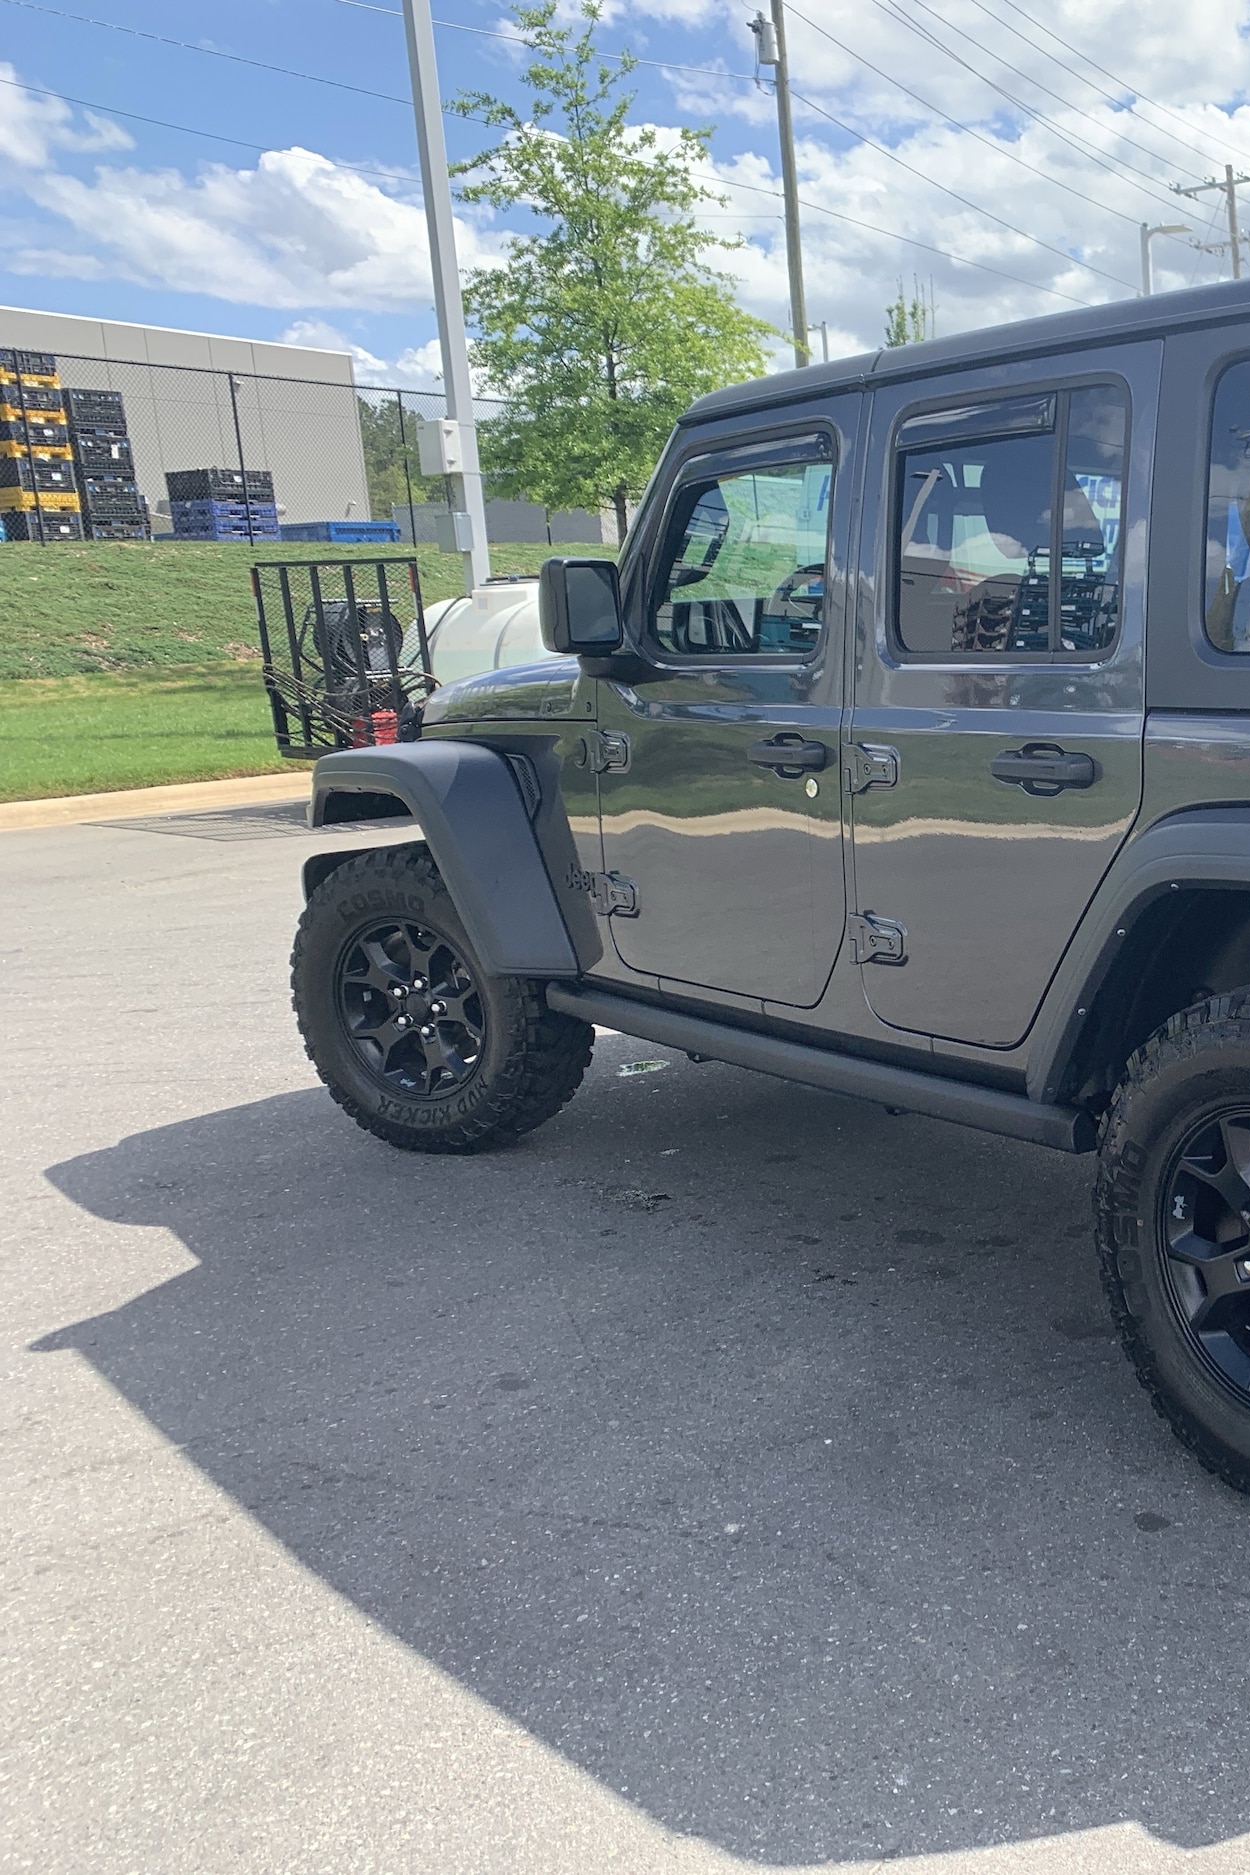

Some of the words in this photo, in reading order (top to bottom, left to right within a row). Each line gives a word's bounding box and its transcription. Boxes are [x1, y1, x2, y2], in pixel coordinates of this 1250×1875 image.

[566, 863, 602, 898] Jeep
[336, 888, 425, 922] COSMO
[377, 1095, 452, 1125] KICKER
[455, 1073, 489, 1114] MUD
